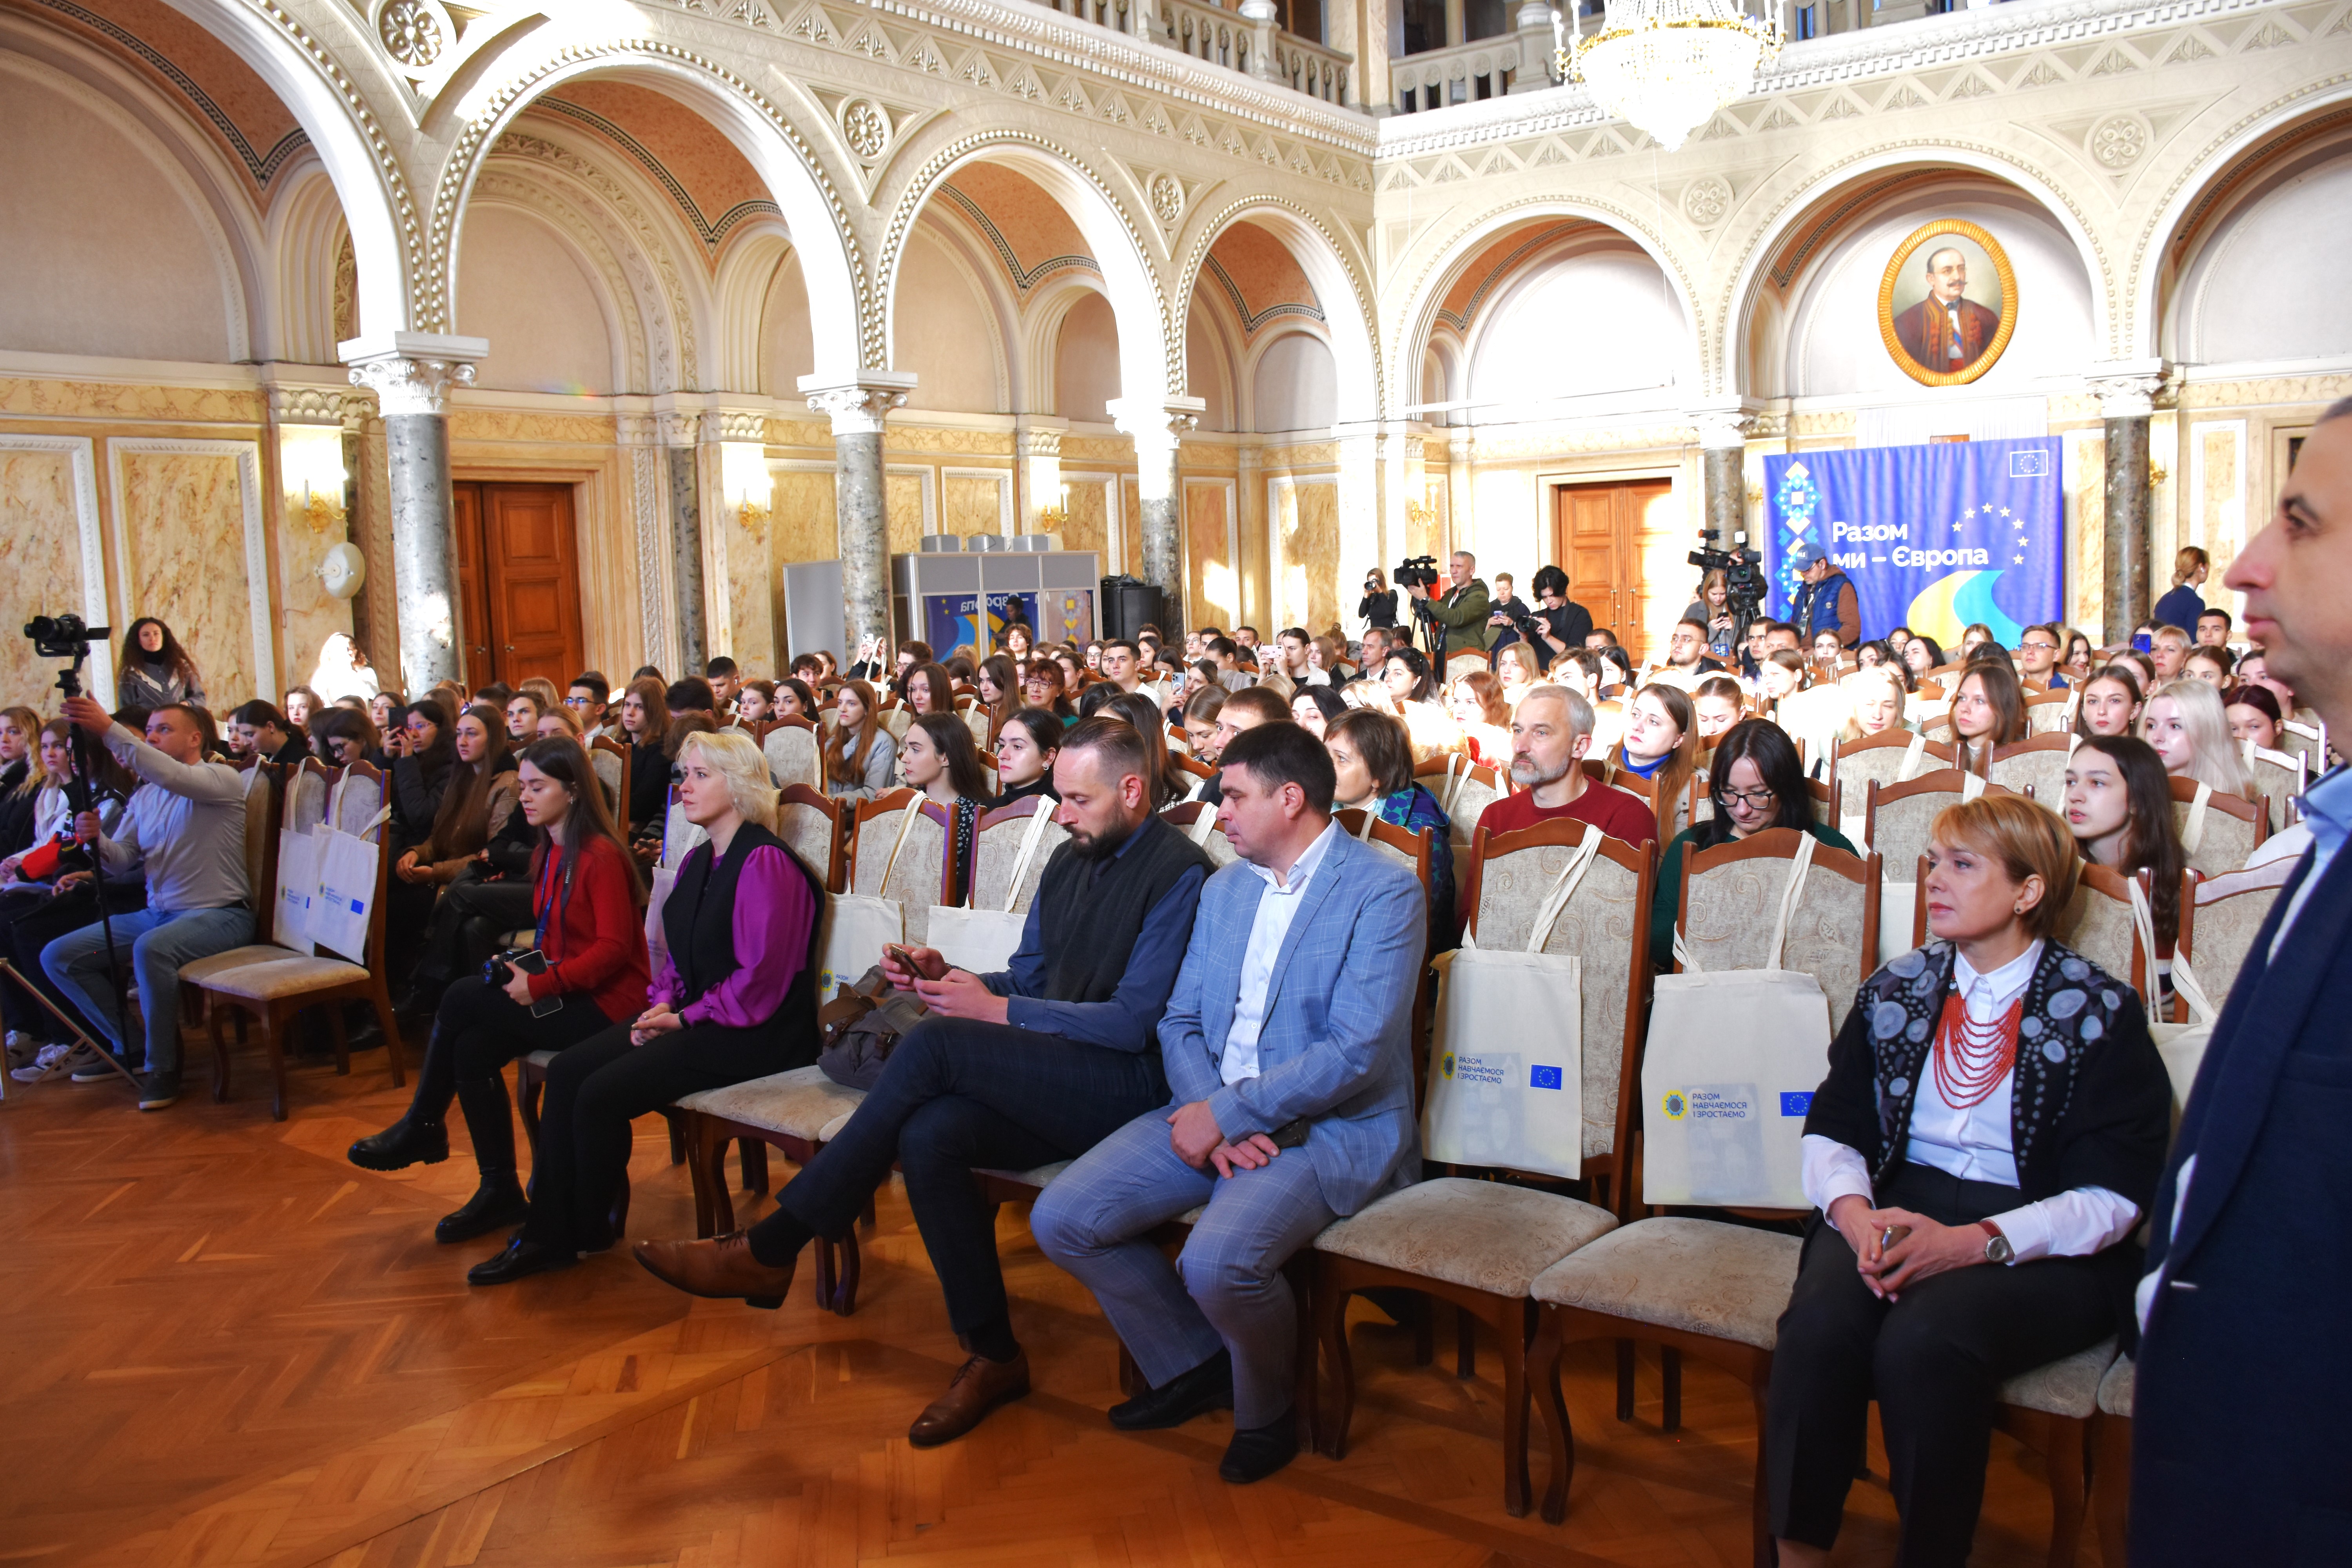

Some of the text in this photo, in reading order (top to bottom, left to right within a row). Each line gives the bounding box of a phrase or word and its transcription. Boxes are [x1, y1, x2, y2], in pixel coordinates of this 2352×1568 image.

[1833, 521, 1908, 543] Разом
[1833, 552, 1866, 568] ми
[1892, 546, 1989, 572] Європа
[1459, 1056, 1481, 1065] РАЗОМ
[1458, 1065, 1504, 1076] НАВЧАЄМОСЯ
[1461, 1073, 1502, 1083] ЗРОСТАЄМО
